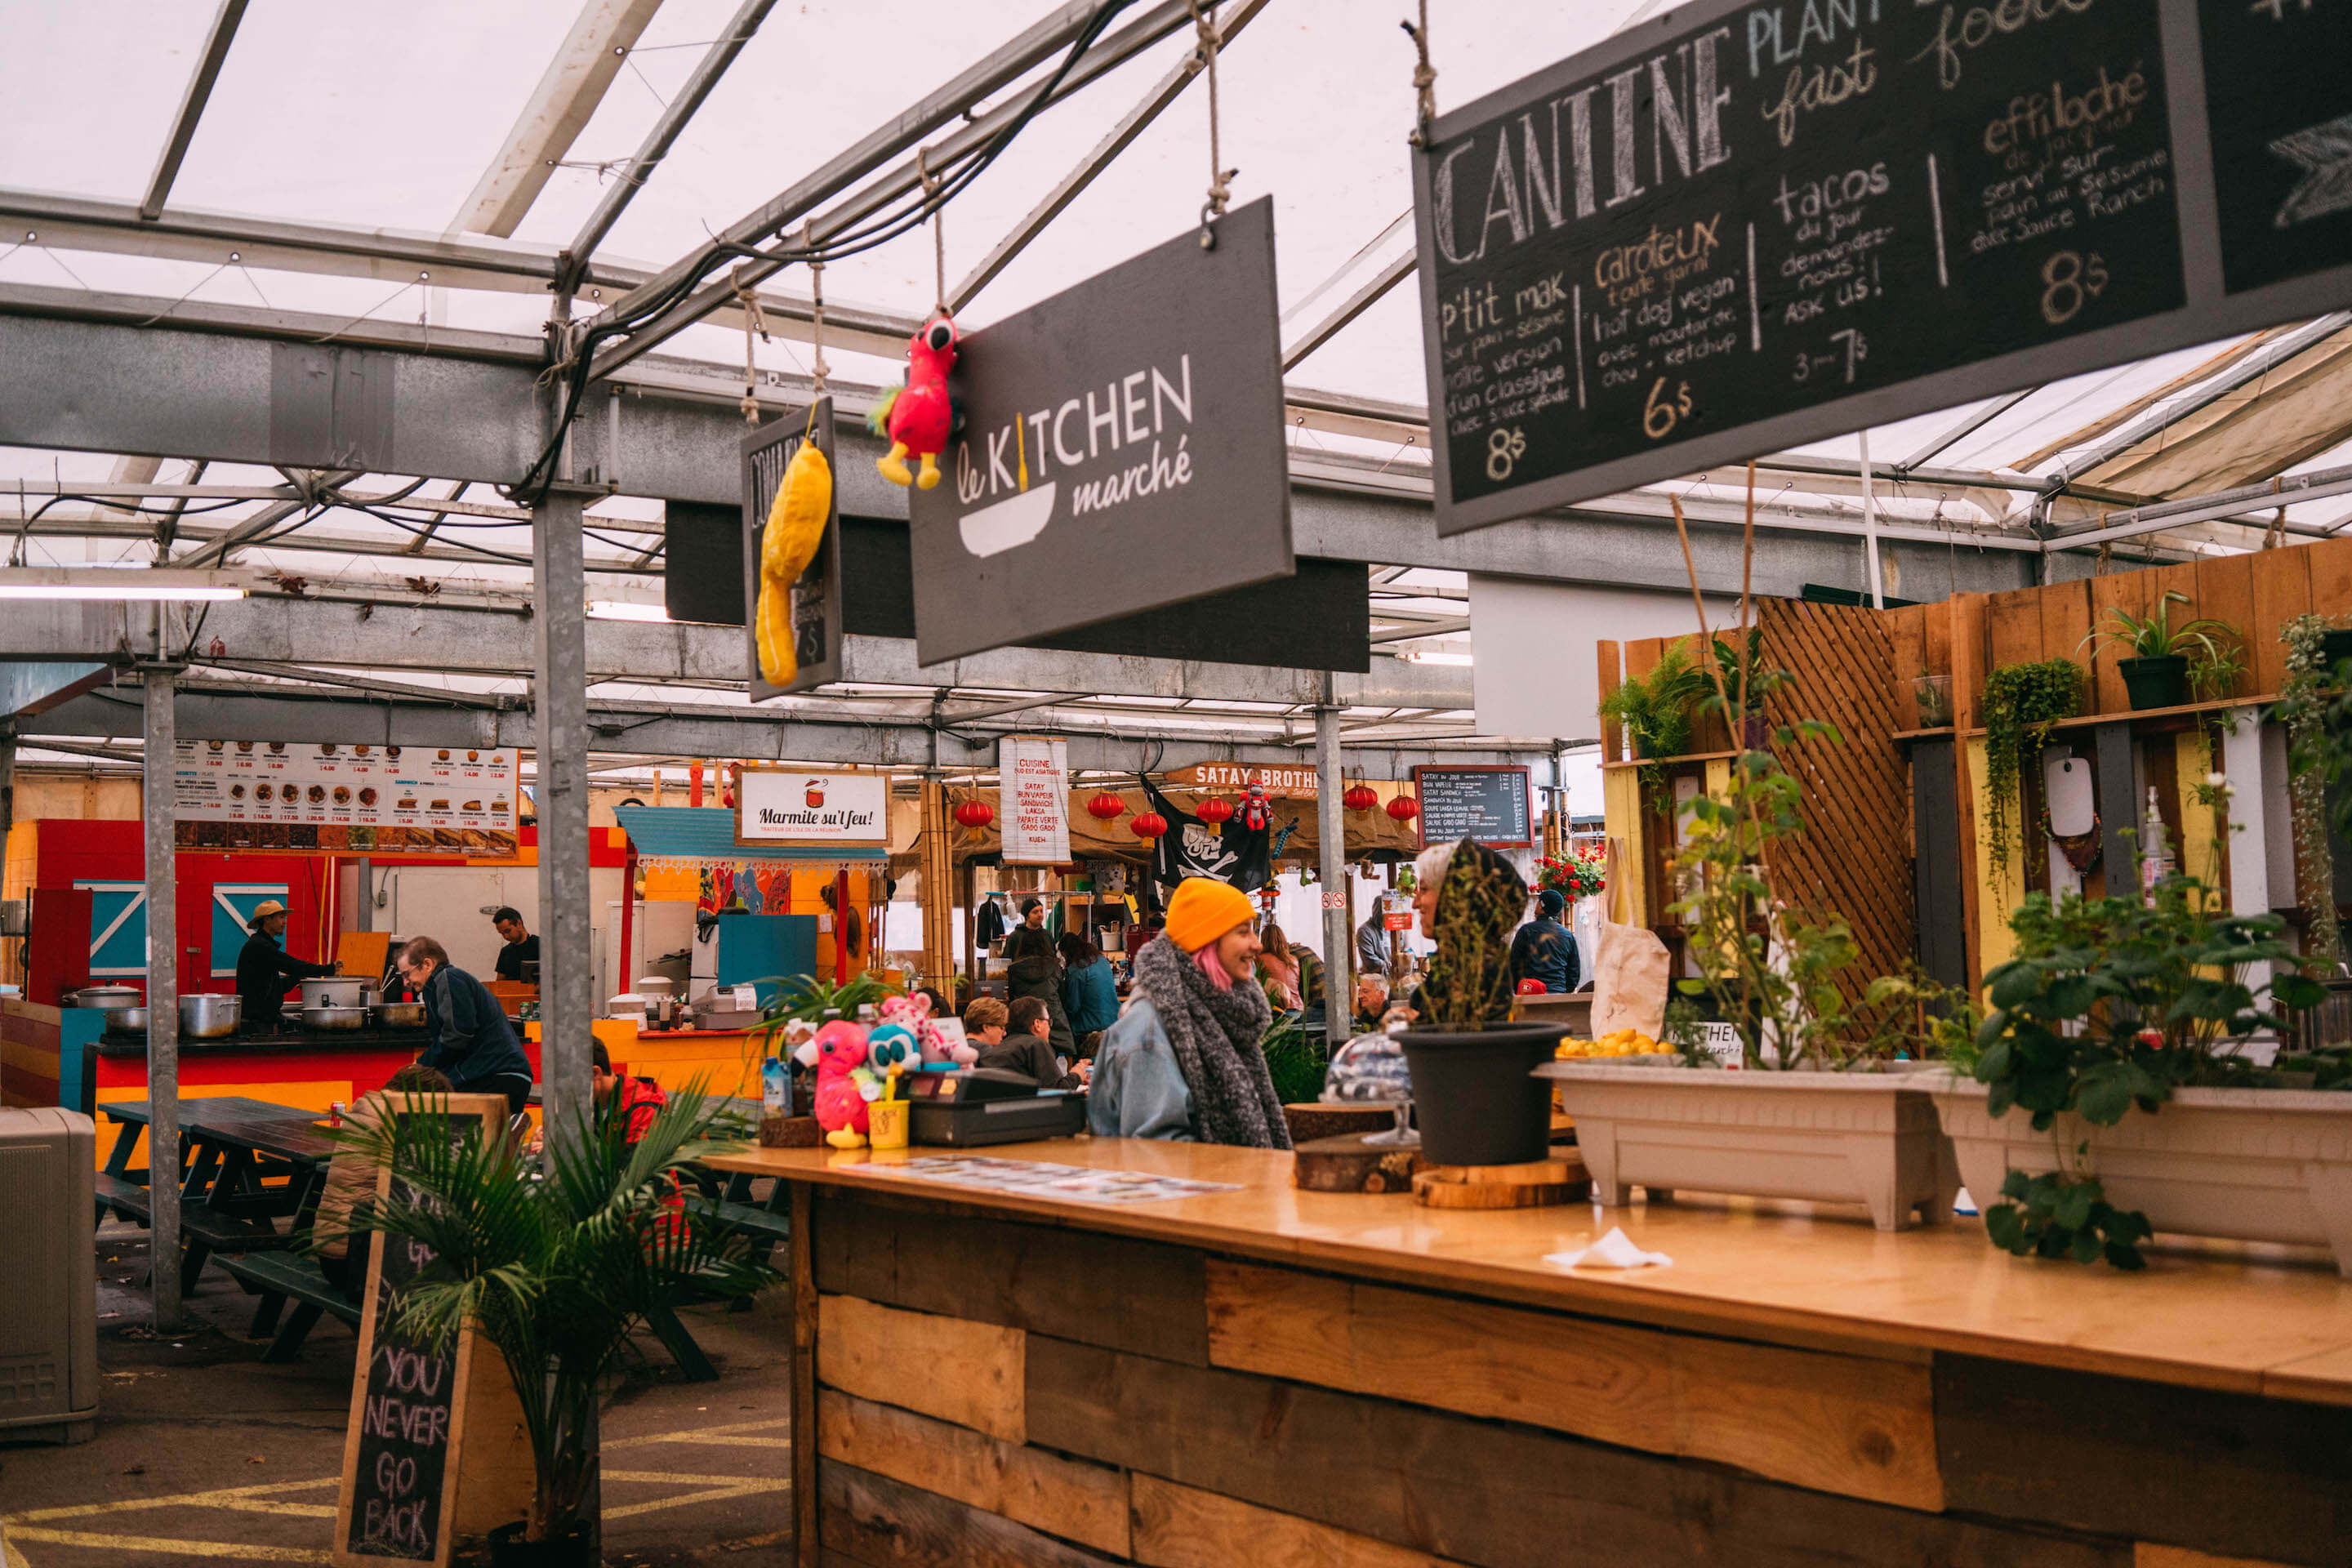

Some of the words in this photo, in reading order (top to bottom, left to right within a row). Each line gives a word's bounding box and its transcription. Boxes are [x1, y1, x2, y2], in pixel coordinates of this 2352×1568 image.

[1762, 32, 1878, 148] fast
[1434, 26, 1731, 265] CANTINE
[1772, 161, 1890, 225] tacos
[1515, 269, 1568, 316] mak
[1635, 295, 1673, 327] dog
[957, 441, 987, 505] le
[987, 354, 1193, 495] KITCHEN
[1071, 434, 1193, 517] marché
[1019, 759, 1050, 768] CUISINE
[1025, 782, 1045, 791] SATAY
[1196, 766, 1253, 786] SATAY
[760, 808, 818, 824] Marmite
[1018, 791, 1030, 799] BUN
[1031, 791, 1054, 800] VAPEUR
[1020, 800, 1054, 808] SANDWICH
[1018, 816, 1039, 824] PAPAYE
[385, 1345, 443, 1397] YOU
[363, 1393, 449, 1447] NEVER
[376, 1450, 416, 1500] GO
[364, 1495, 430, 1549] BACK
